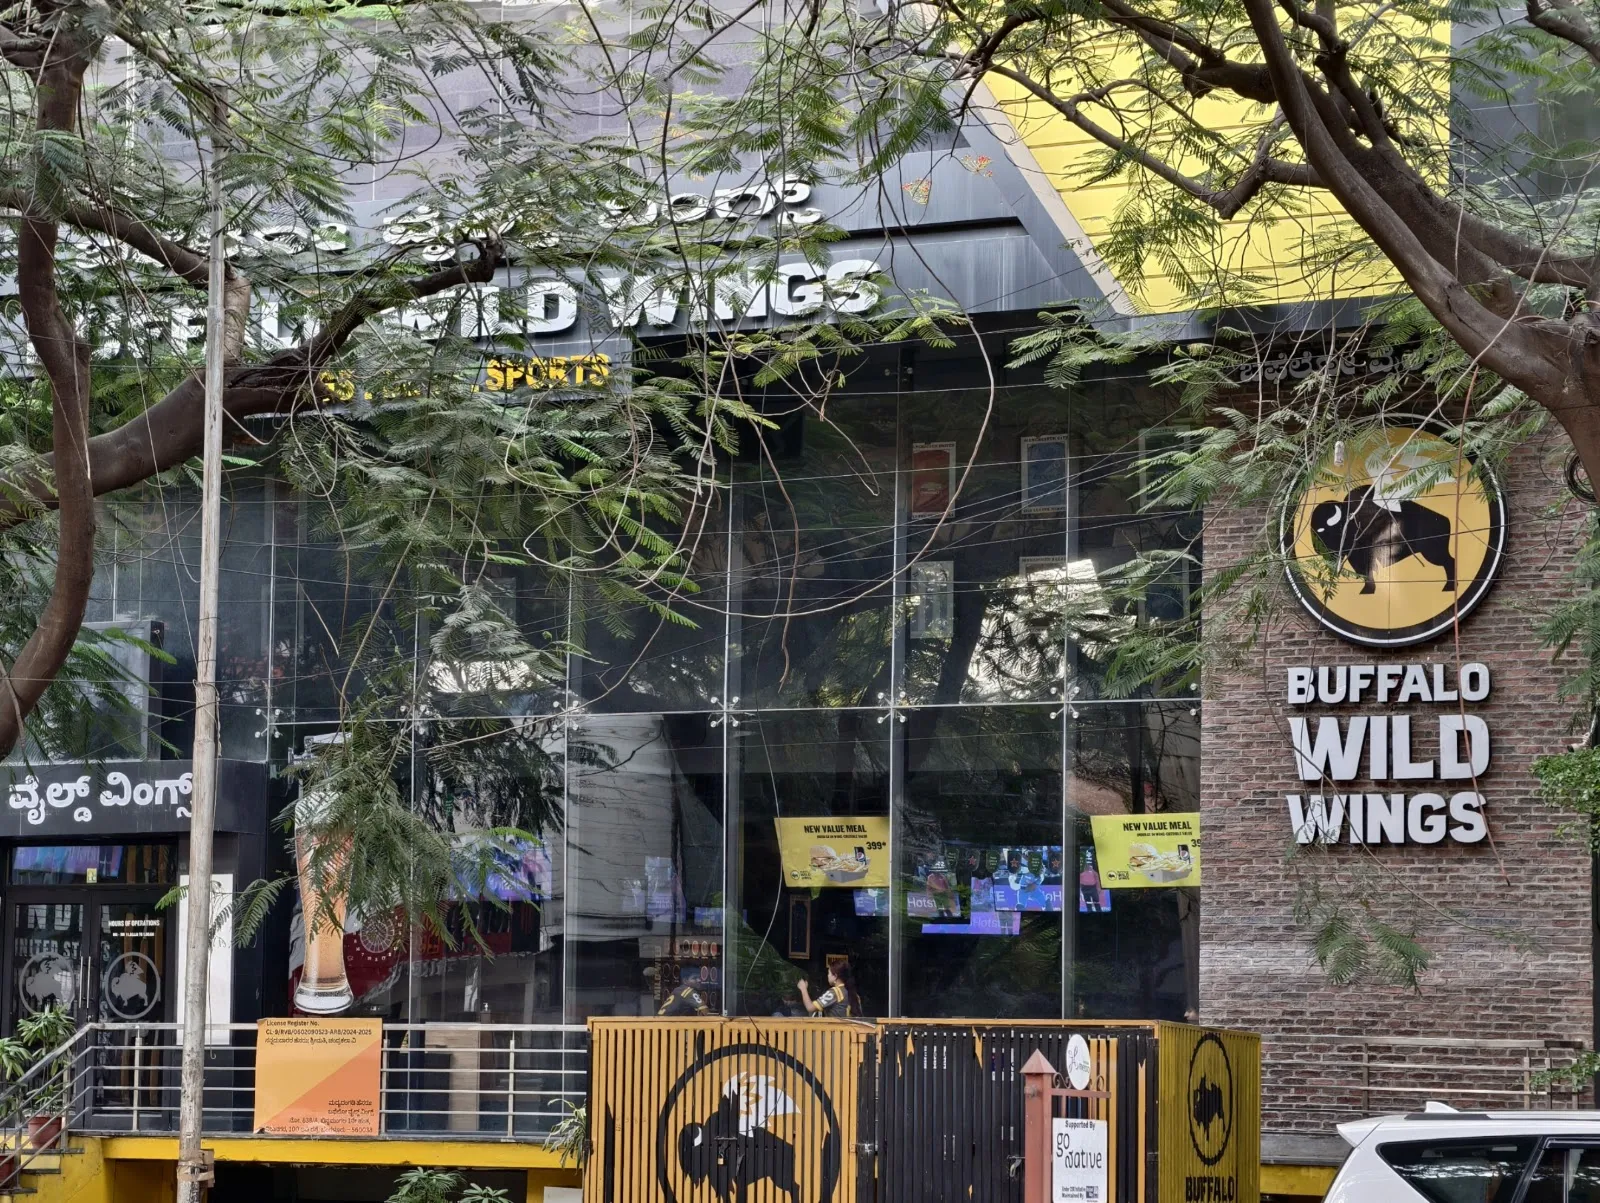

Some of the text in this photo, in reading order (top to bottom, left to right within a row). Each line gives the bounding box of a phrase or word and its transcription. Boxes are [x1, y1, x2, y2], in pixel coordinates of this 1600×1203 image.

[600, 259, 882, 328] WINGS
[485, 354, 610, 392] SPORTS
[1287, 663, 1490, 704] BUFFALO
[1287, 715, 1490, 780] WILD
[804, 824, 867, 833] NEW VALUE MEAL
[1123, 820, 1192, 831] NEW VALUE MEAL
[1286, 792, 1487, 844] WINGS
[287, 1020, 309, 1028] Register
[1065, 1120, 1095, 1130] Supported By
[1056, 1132, 1070, 1158] go
[1185, 1175, 1235, 1202] BUFFALO
